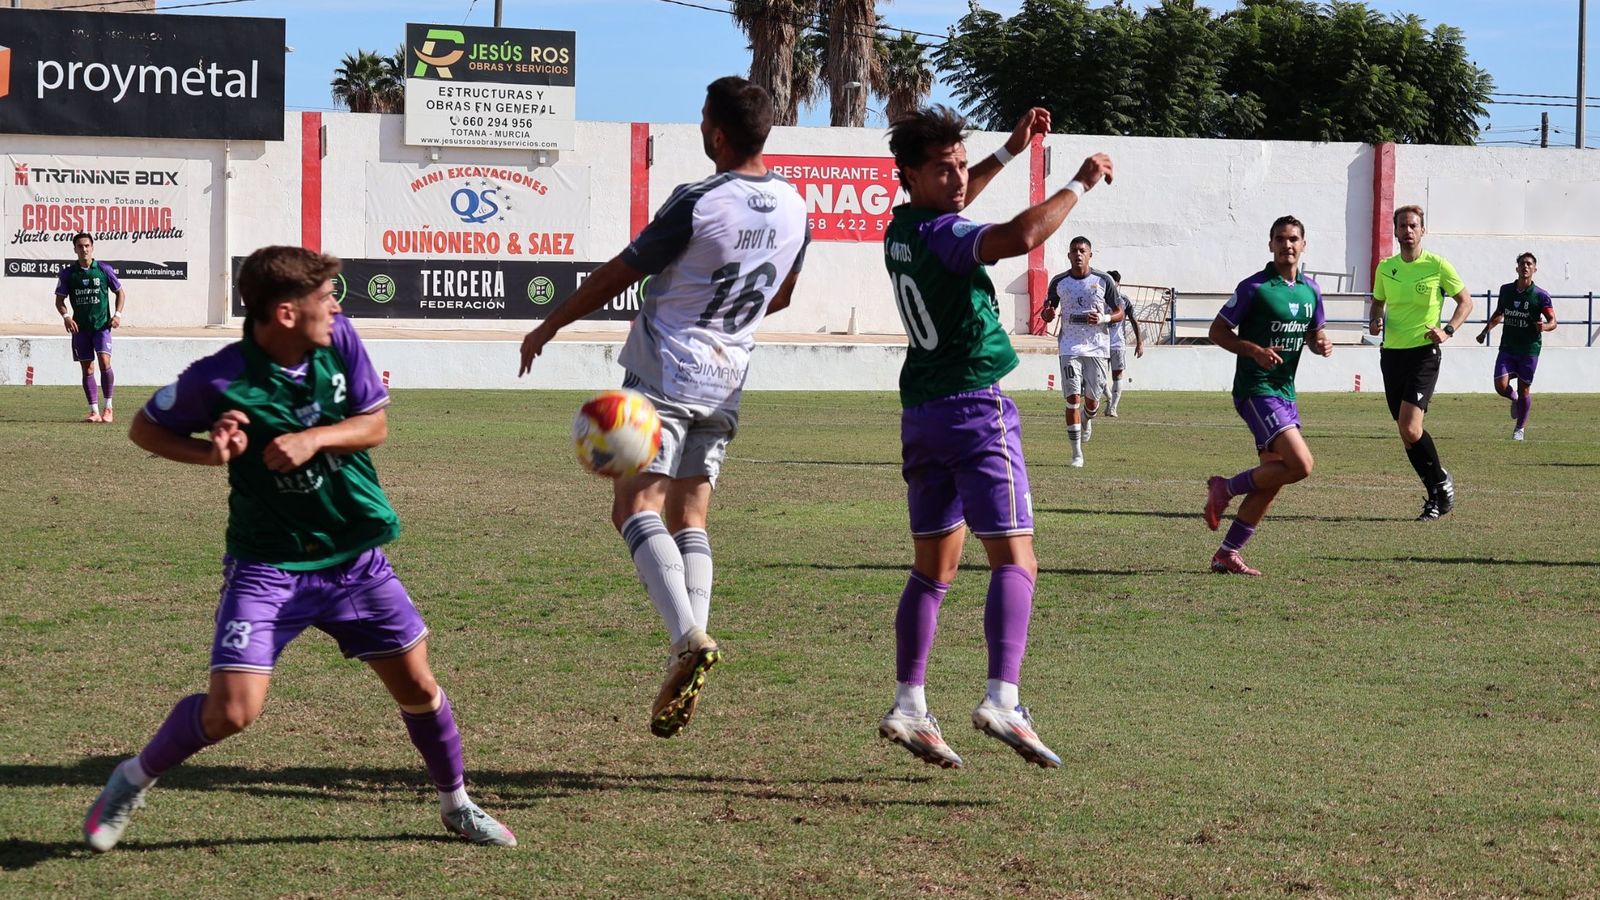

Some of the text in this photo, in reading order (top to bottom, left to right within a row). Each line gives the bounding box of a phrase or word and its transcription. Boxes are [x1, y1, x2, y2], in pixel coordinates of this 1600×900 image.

[468, 40, 569, 63] JESÚS ROS
[469, 62, 568, 74] OBRAS Y SERVICIOS
[37, 60, 258, 103] proymetal
[439, 87, 544, 100] ESTRUCTURAS Y
[426, 100, 556, 115] OBRAS EN GENERAL
[462, 116, 533, 129] 660 294 956
[451, 129, 487, 138] TOTANA
[494, 130, 530, 139] MURCIA
[421, 137, 558, 148] www.jesusrosobrasyservicios.com
[135, 171, 179, 186] BOX
[773, 166, 879, 180] RESTAURANTE
[410, 167, 548, 196] MINI EXCAVACIONES
[35, 193, 60, 203] Único
[65, 196, 95, 204] centro
[115, 197, 144, 205] Totana
[23, 204, 172, 233] CROSSTRAINING
[837, 219, 866, 230] 422
[11, 229, 50, 244] Hazte
[132, 227, 183, 244] gratuita
[382, 225, 574, 255] QUIÑONERO & SAEZ
[734, 229, 777, 250] JAVI R.
[21, 262, 36, 273] 602
[39, 263, 48, 273] 13
[49, 264, 60, 273] 45
[126, 267, 184, 277] www.mktraining.es
[92, 277, 101, 287] 18
[421, 270, 505, 297] TERCERA
[420, 299, 505, 309] FEDERACIÓN
[696, 262, 777, 334] 16
[1303, 303, 1313, 318] 11
[1524, 302, 1530, 310] 8
[1063, 365, 1075, 379] 10
[1264, 411, 1280, 429] 11
[221, 620, 251, 650] 23
